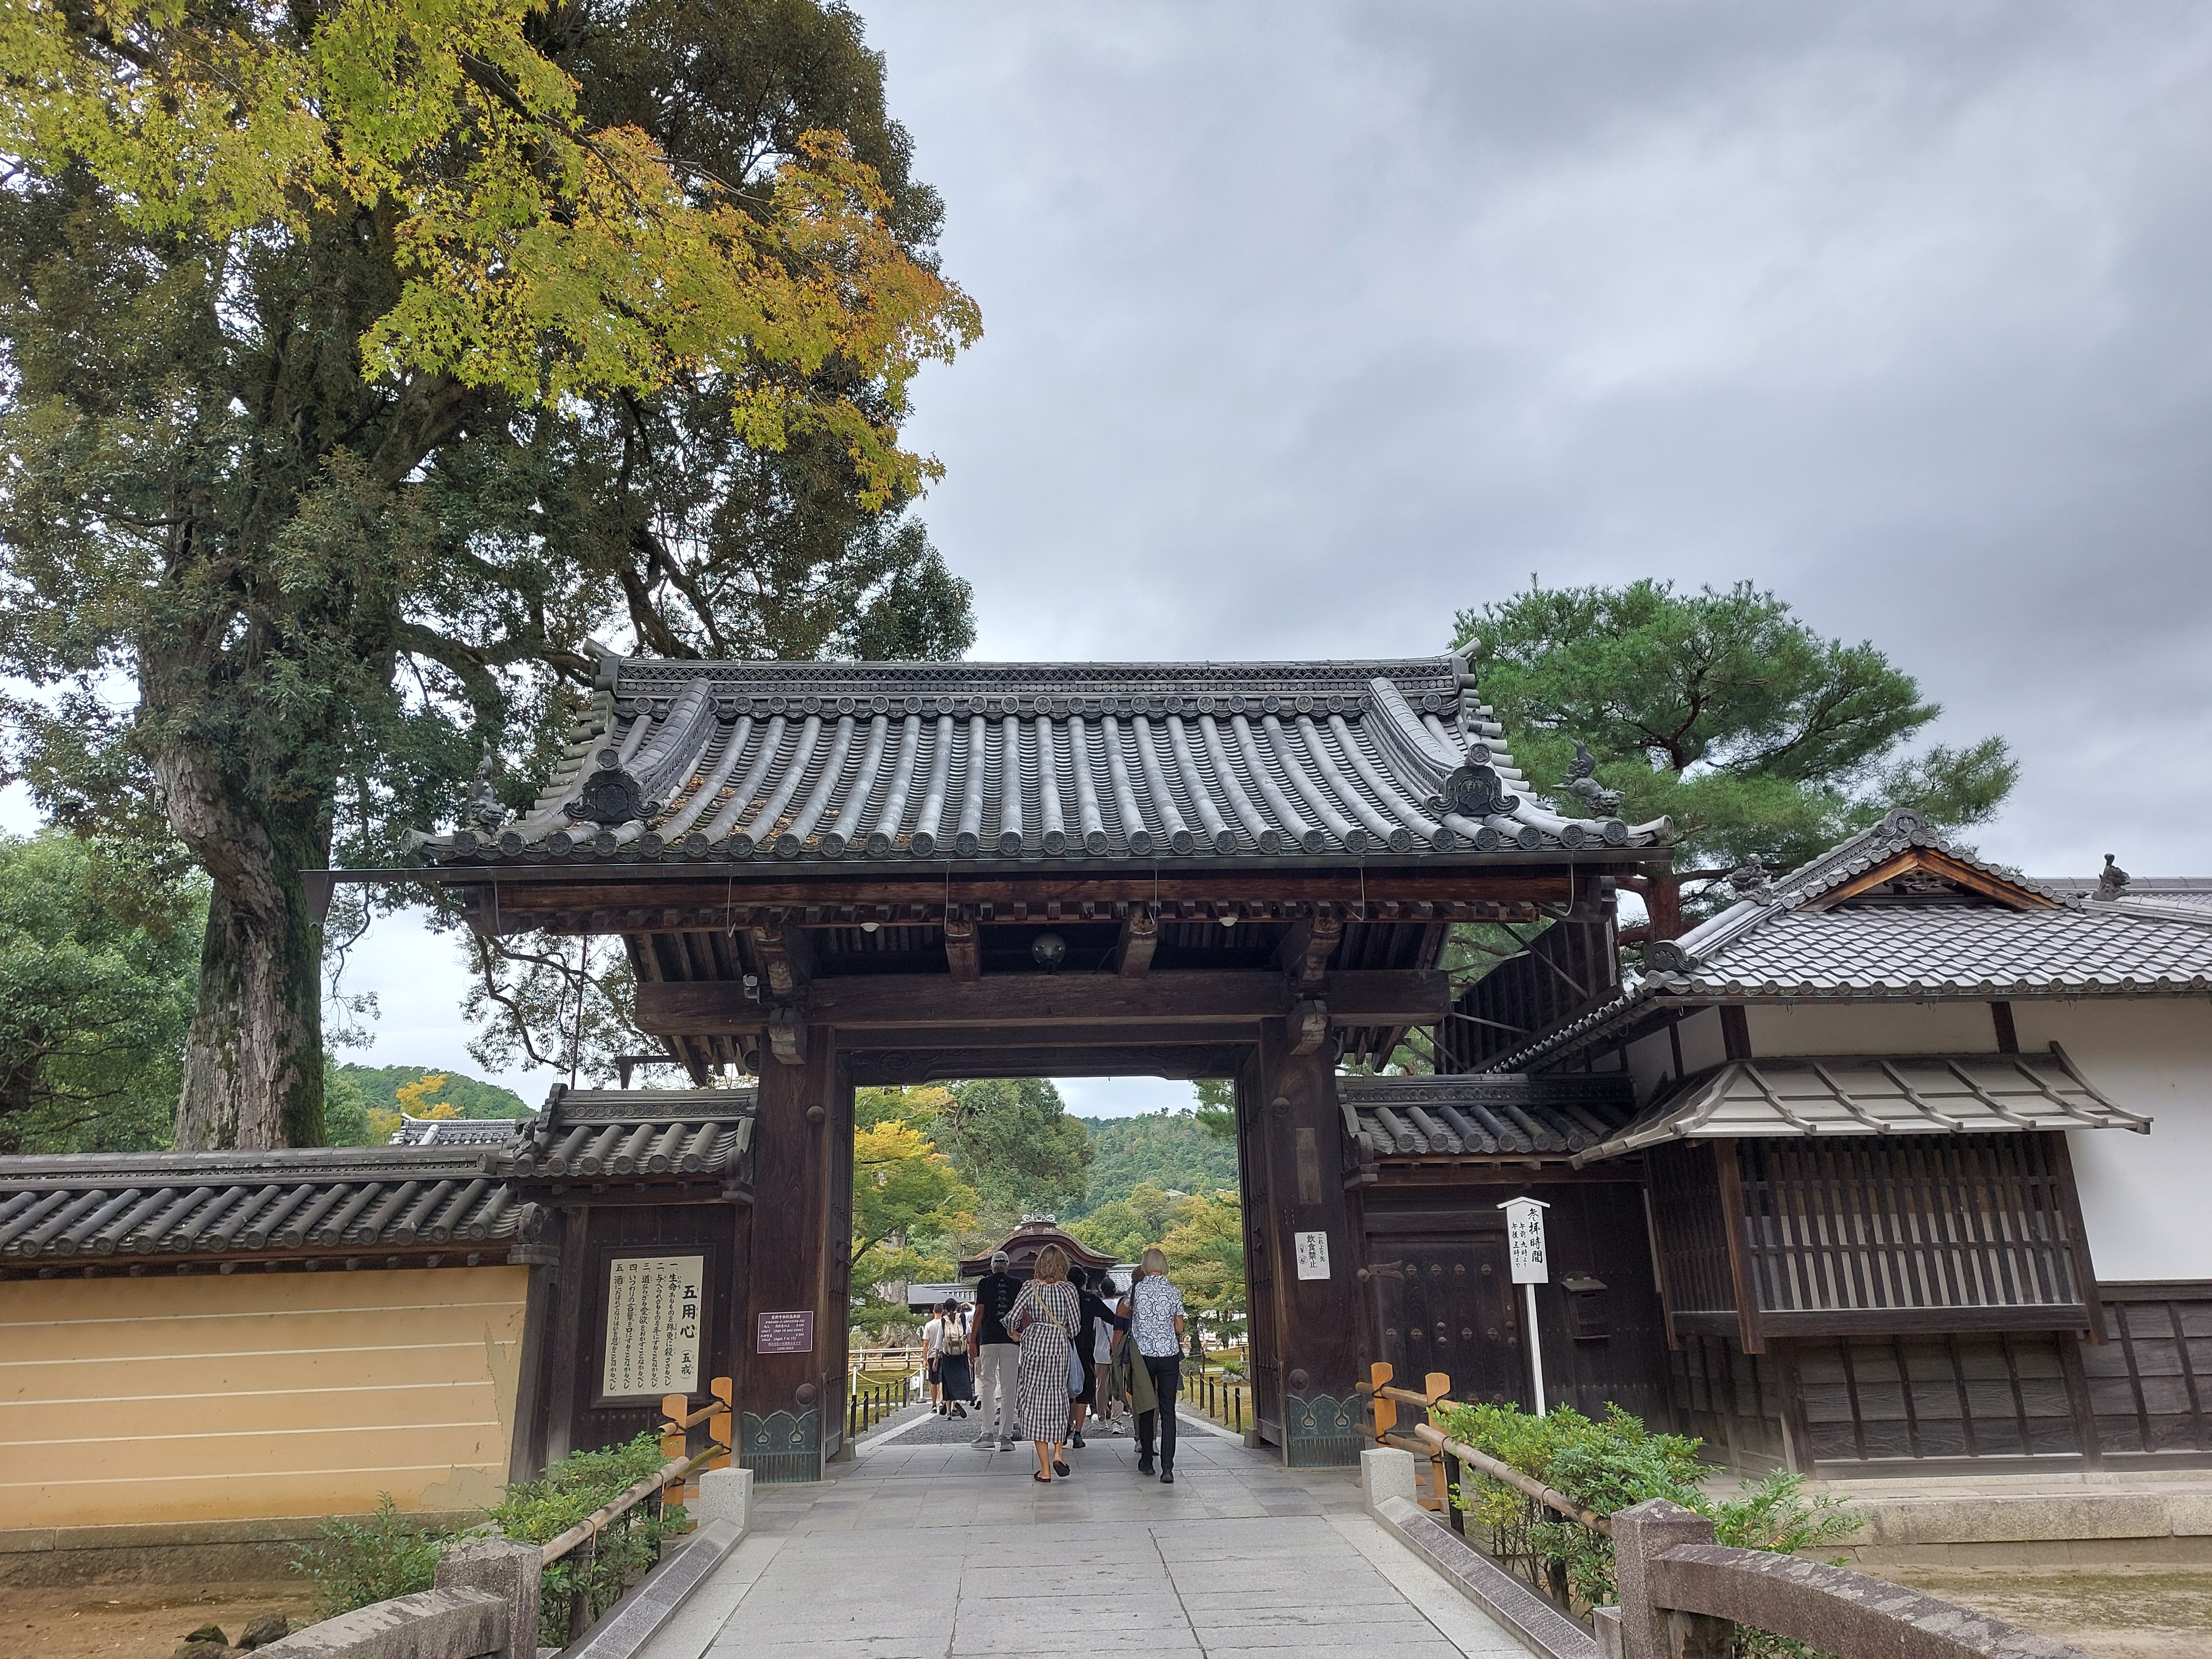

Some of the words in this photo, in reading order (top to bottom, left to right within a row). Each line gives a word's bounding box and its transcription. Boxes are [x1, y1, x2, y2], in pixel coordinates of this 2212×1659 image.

[1307, 1234, 1317, 1268] 飲食禁止
[1511, 1222, 1520, 1268] 午後五時まで
[1519, 1222, 1527, 1268] 午前九時より
[680, 1284, 697, 1338] 五用心
